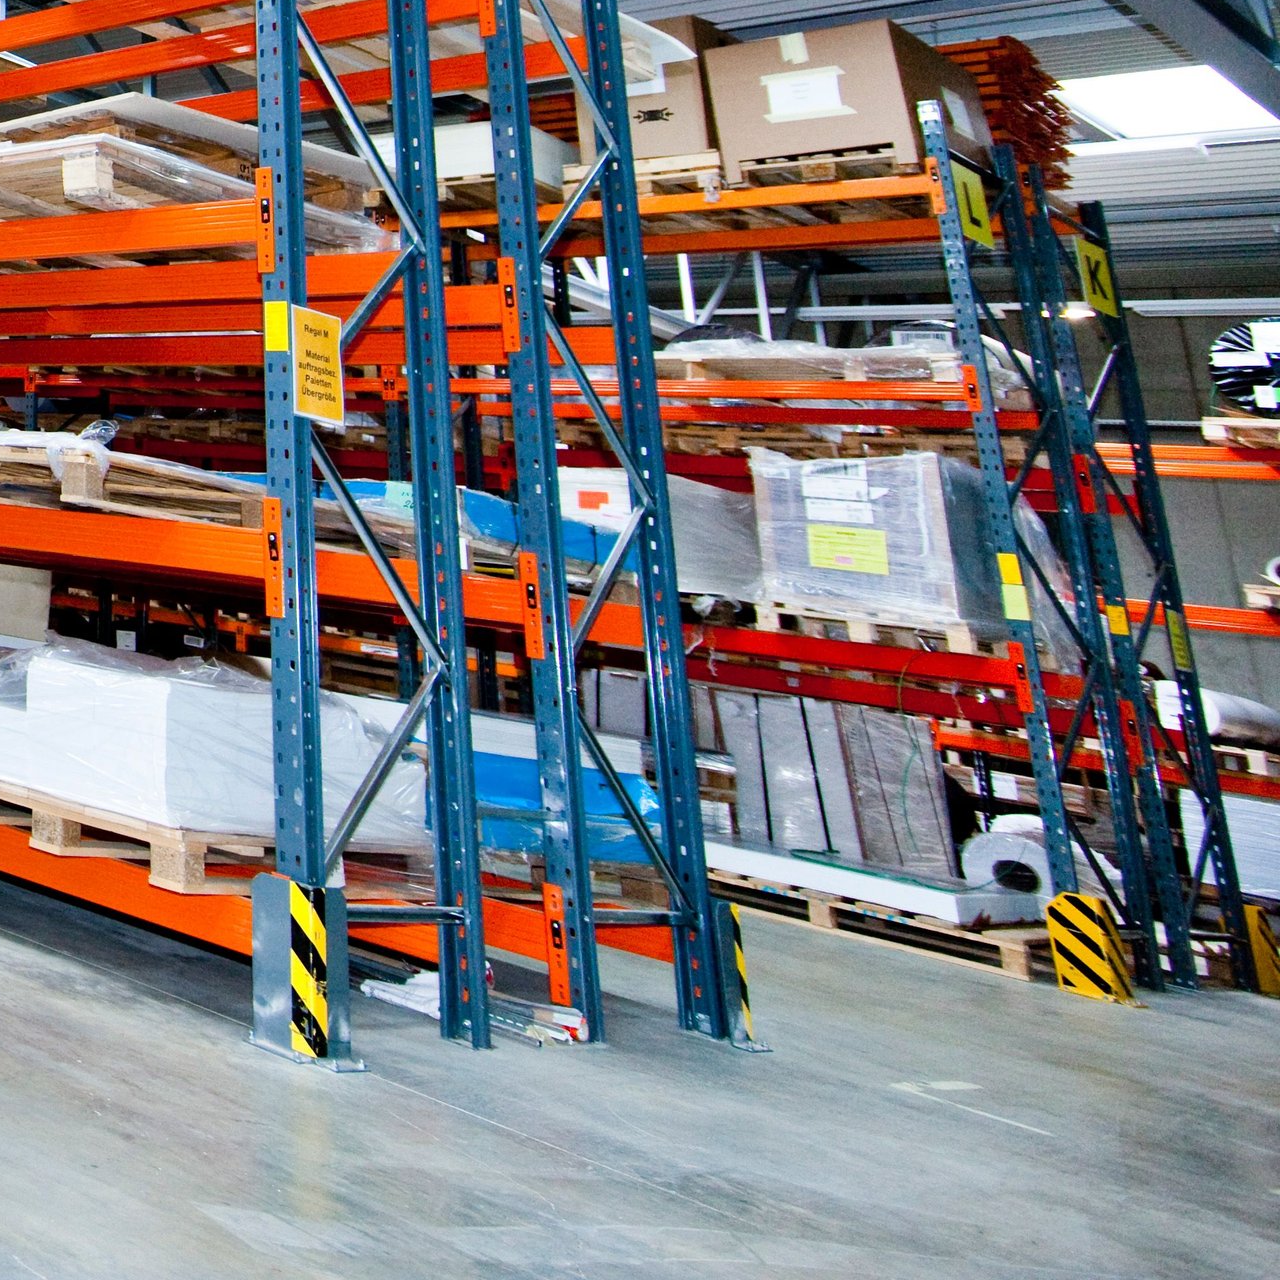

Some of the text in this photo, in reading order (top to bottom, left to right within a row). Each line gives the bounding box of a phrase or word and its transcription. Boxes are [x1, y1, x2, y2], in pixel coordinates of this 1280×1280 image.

[962, 181, 982, 228] L
[1085, 254, 1109, 301] K
[304, 323, 329, 339] Regal M
[305, 349, 331, 364] Material
[305, 374, 333, 389] Paletten
[301, 384, 337, 404] Übergröße
